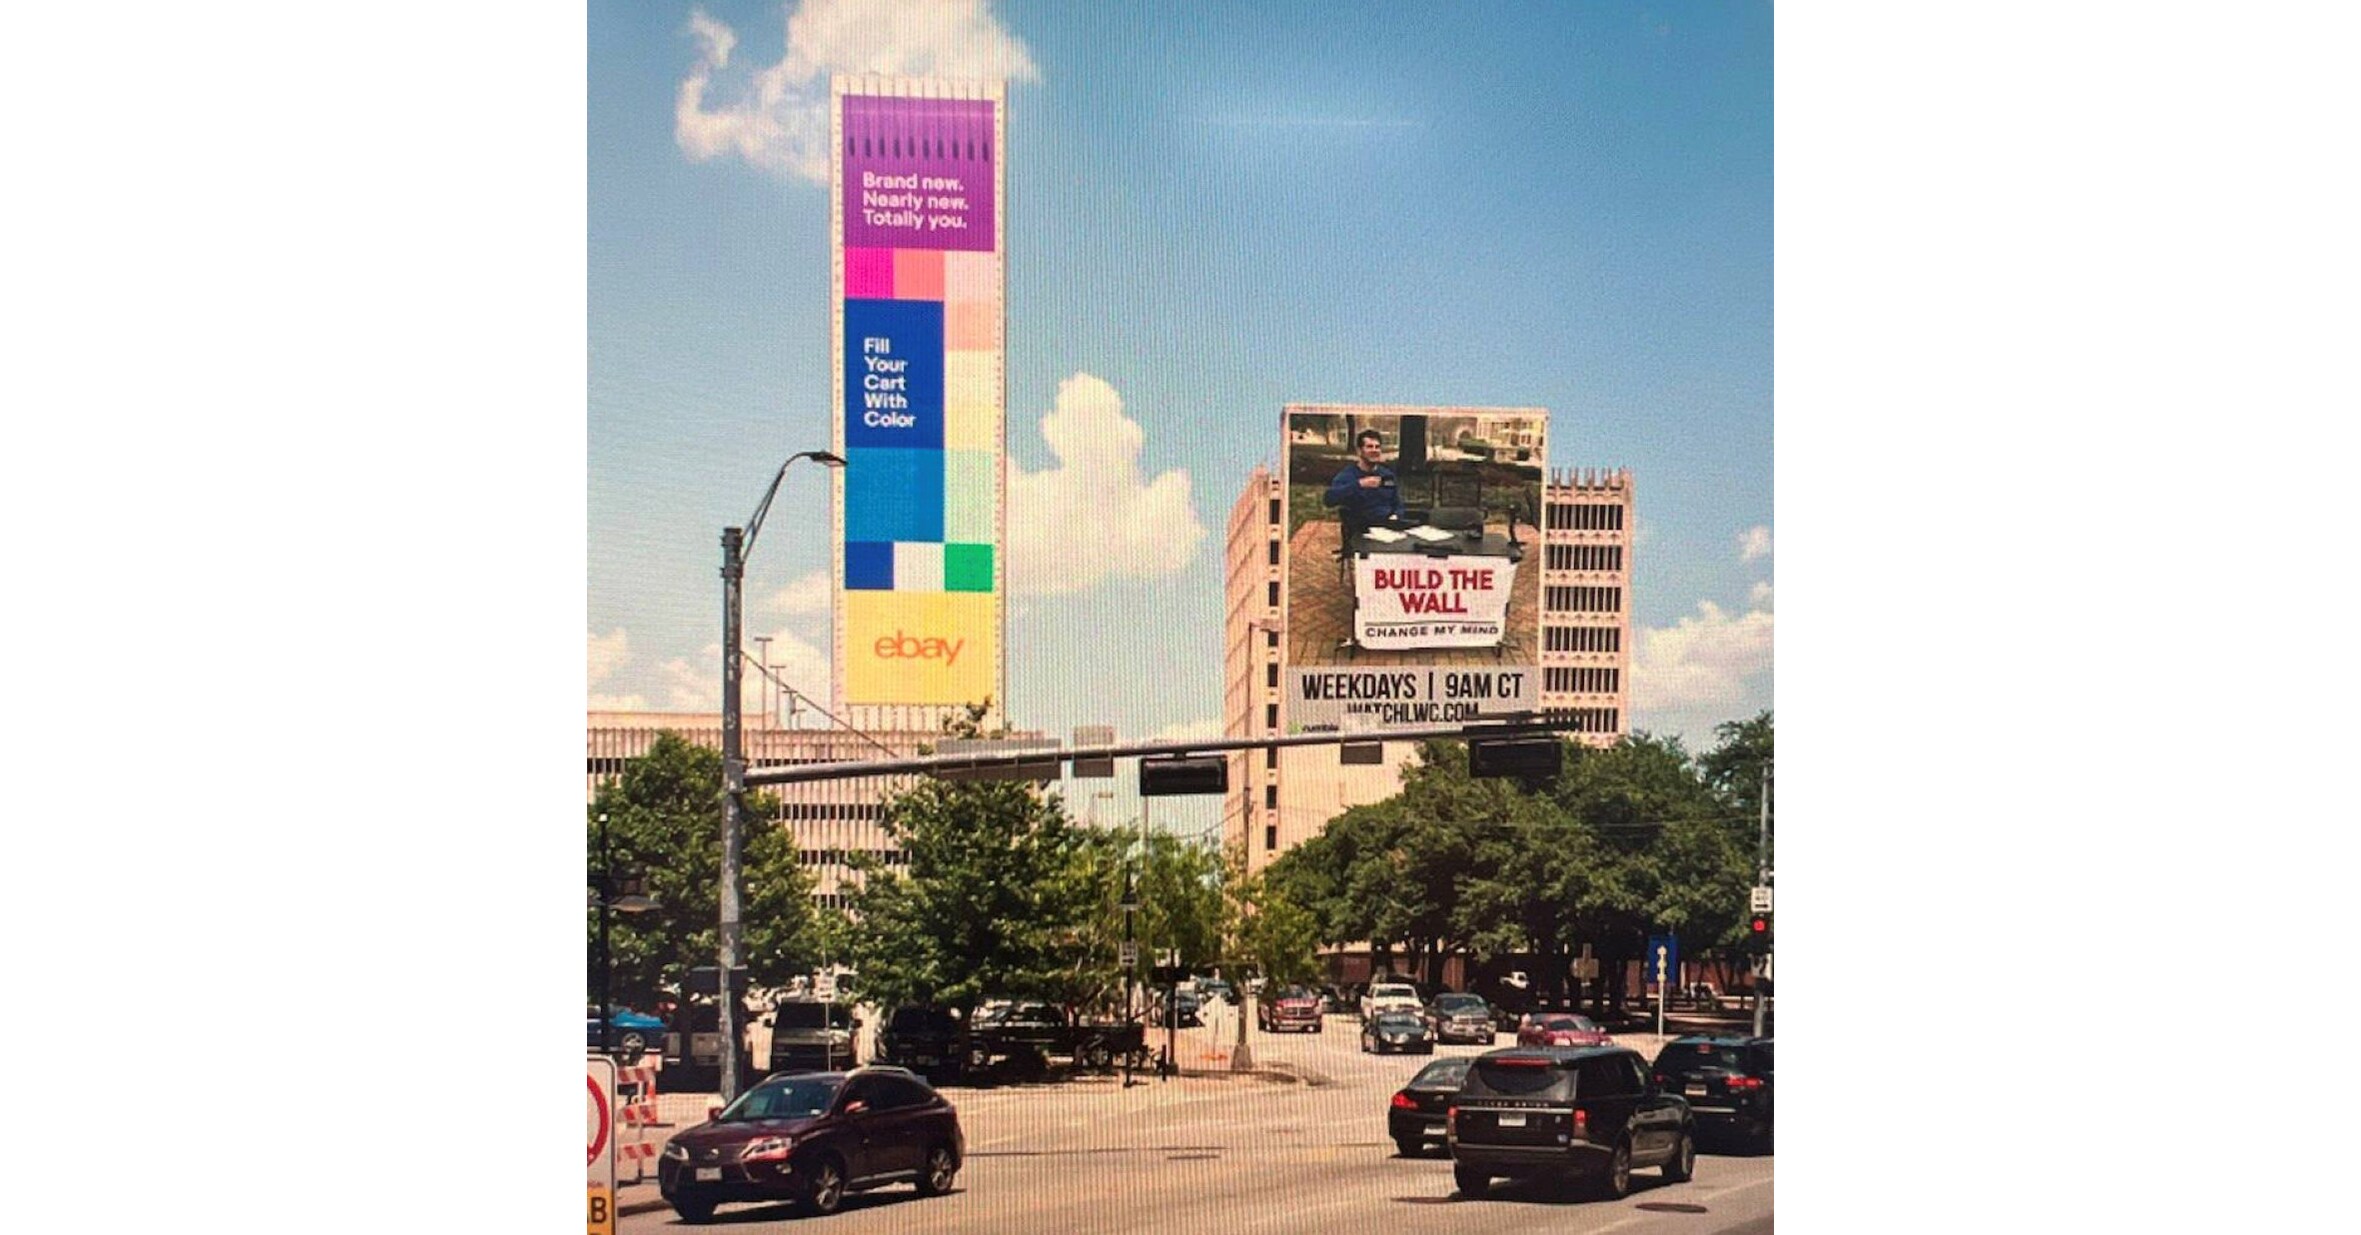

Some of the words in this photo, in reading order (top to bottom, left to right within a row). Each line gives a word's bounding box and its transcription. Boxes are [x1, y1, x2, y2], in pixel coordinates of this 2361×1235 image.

[863, 171, 918, 189] Brand
[922, 177, 964, 191] new.
[863, 190, 923, 211] Nearly
[928, 196, 969, 210] new.
[863, 209, 923, 231] Totally
[928, 215, 967, 231] you.
[864, 337, 890, 354] Fill
[864, 355, 908, 373] Your
[864, 374, 906, 391] Cart
[864, 391, 908, 408] With
[864, 410, 917, 428] Color
[1374, 569, 1443, 590] BUILD
[1448, 569, 1494, 590] THE
[1398, 592, 1468, 613] WALL
[1365, 626, 1429, 638] CHANGE
[1434, 625, 1457, 635] MY
[1460, 625, 1499, 635] MIND
[875, 629, 965, 667] ebay
[1302, 673, 1416, 699] WEEKDAYS
[1445, 673, 1492, 698] 9AM
[1498, 673, 1523, 699] CT
